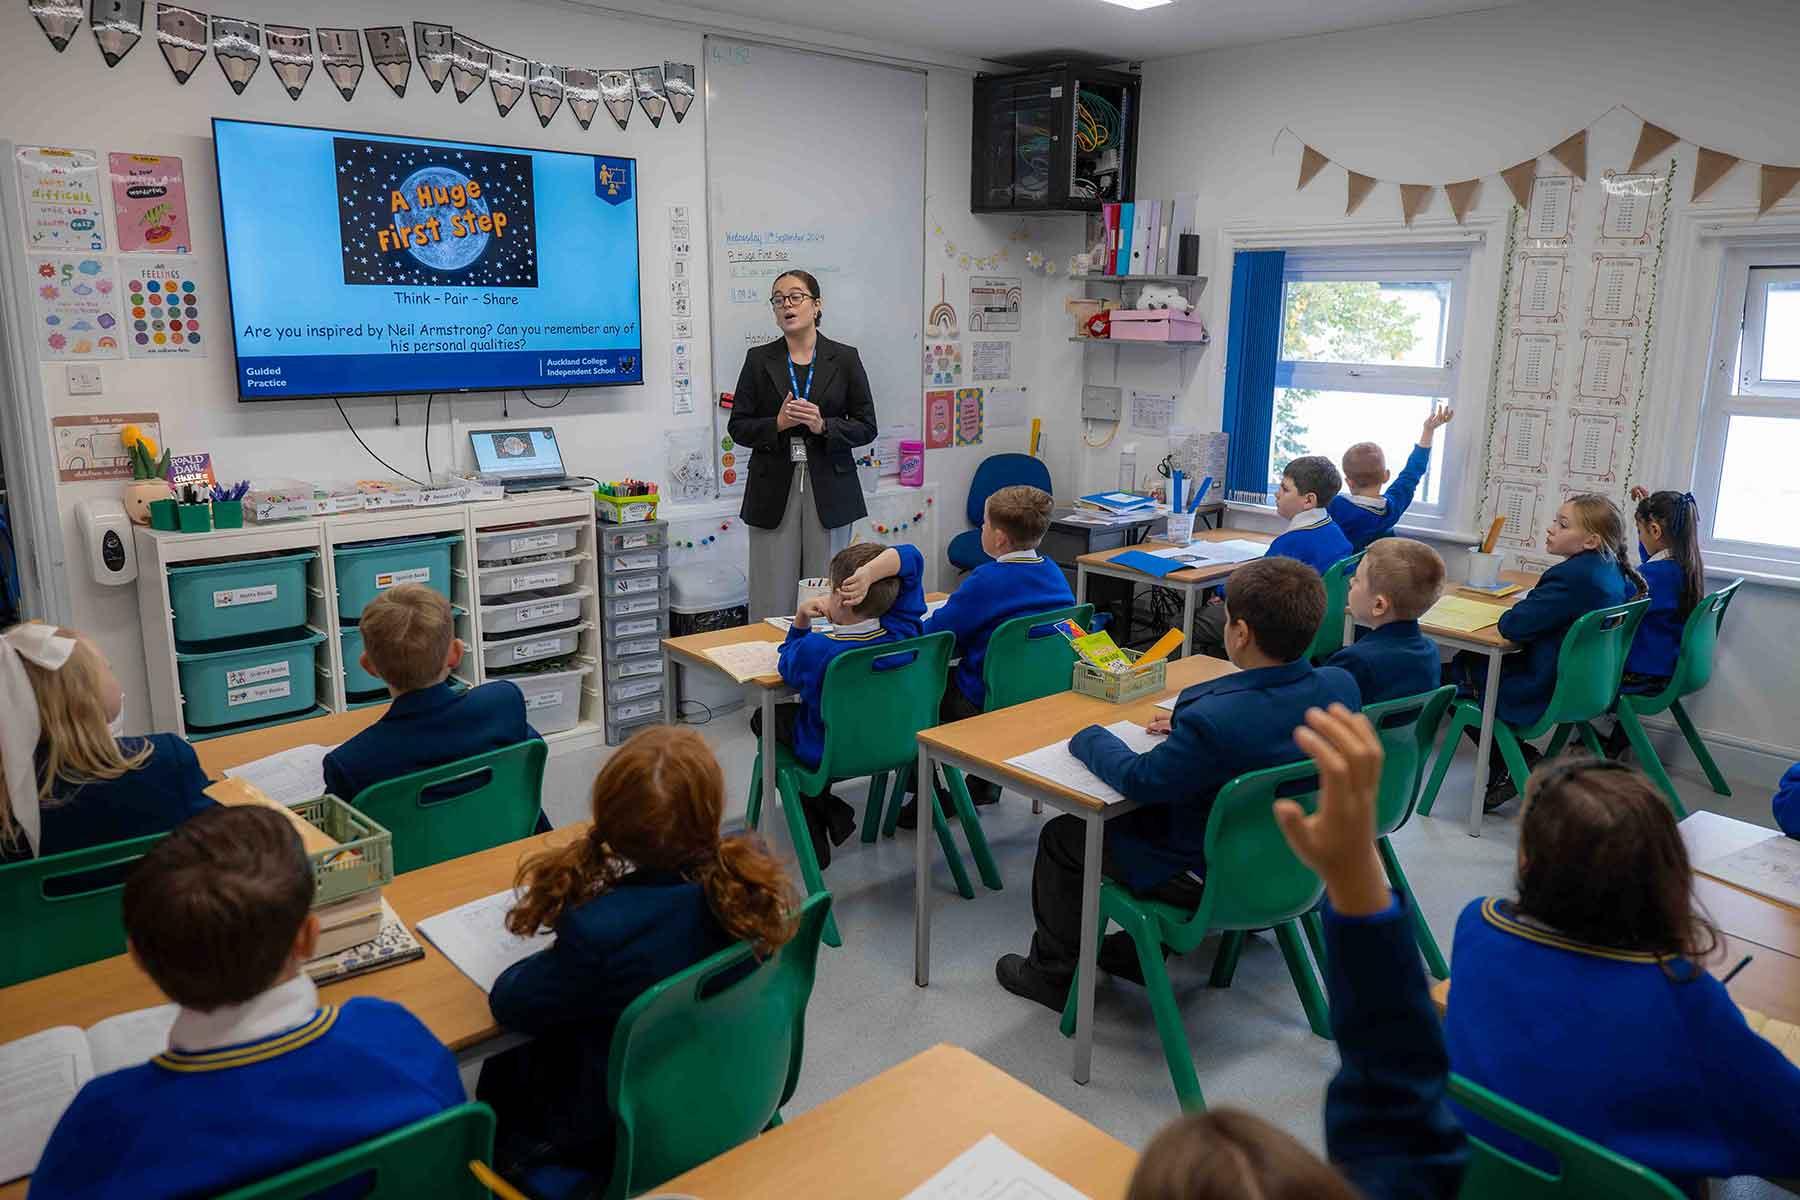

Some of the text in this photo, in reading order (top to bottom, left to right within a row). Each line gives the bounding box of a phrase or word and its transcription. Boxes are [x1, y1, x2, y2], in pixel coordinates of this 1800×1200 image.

[31, 189, 93, 203] difficult
[391, 180, 481, 213] A Huge
[377, 209, 508, 252] First Step
[393, 291, 431, 304] Think
[444, 292, 469, 305] Pair
[483, 293, 519, 305] Share
[244, 322, 635, 341] Are you inspired by Neil Armstrong? Can you remember any of
[390, 338, 527, 354] his personal qualities?
[547, 357, 608, 367] Auckland College
[246, 367, 282, 376] Guided
[547, 367, 616, 377] Independent School
[247, 378, 288, 388] Practice
[170, 455, 204, 467] ROALD
[175, 462, 204, 475] DAHL
[173, 472, 202, 483] CHARLIE
